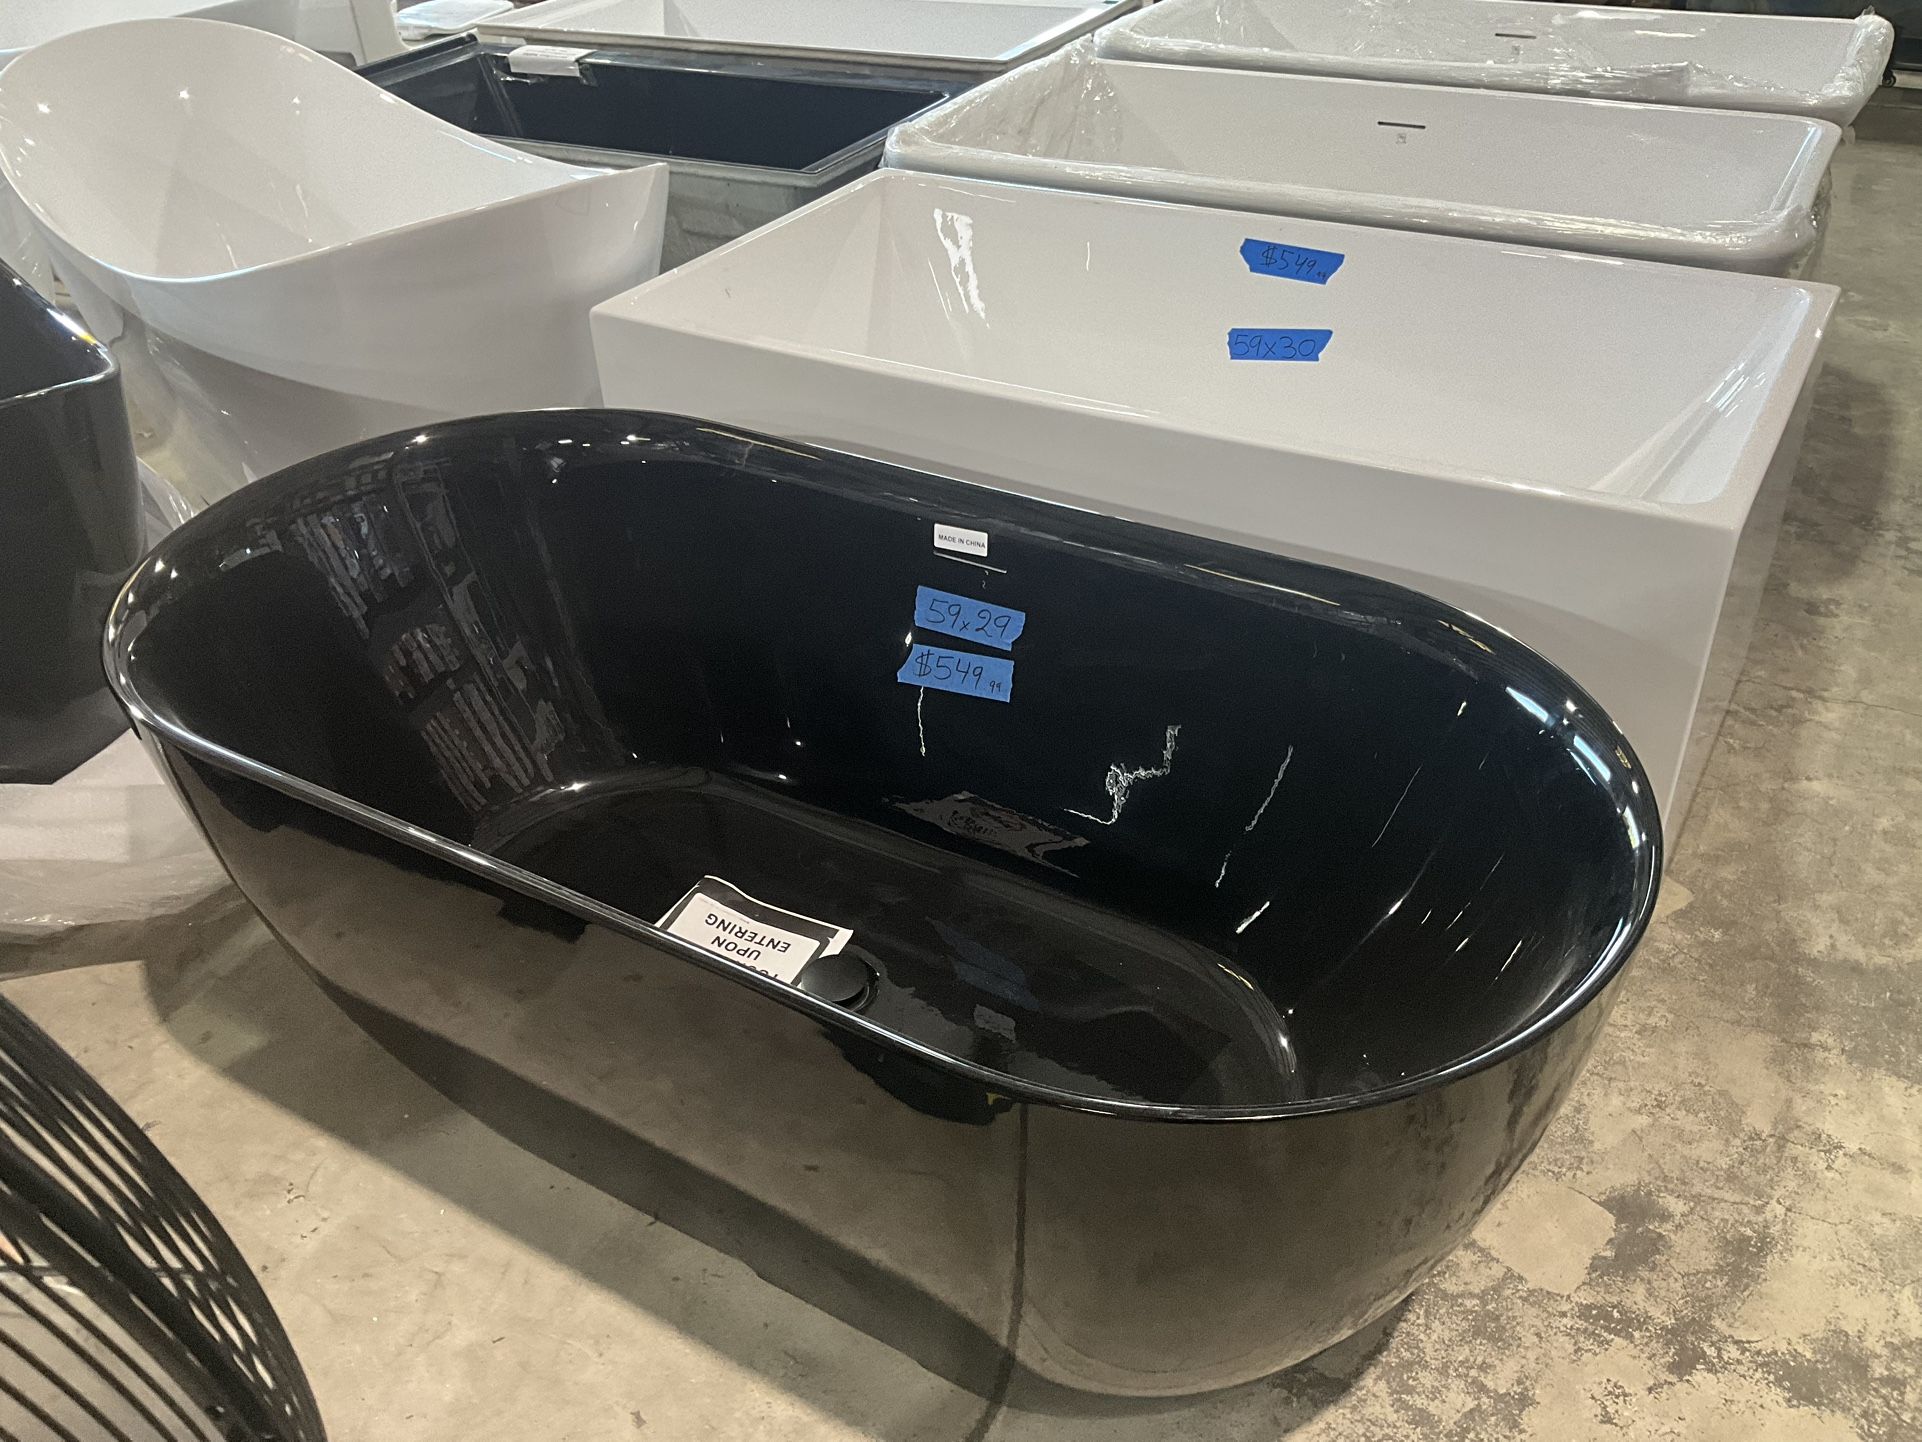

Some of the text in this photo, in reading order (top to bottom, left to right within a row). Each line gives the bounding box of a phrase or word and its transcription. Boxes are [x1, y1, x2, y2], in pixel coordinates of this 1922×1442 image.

[938, 533, 987, 549] MADE IN CHINA
[927, 598, 1012, 638] 59x29
[704, 912, 792, 954] ENTERING
[711, 935, 762, 961] UPON
